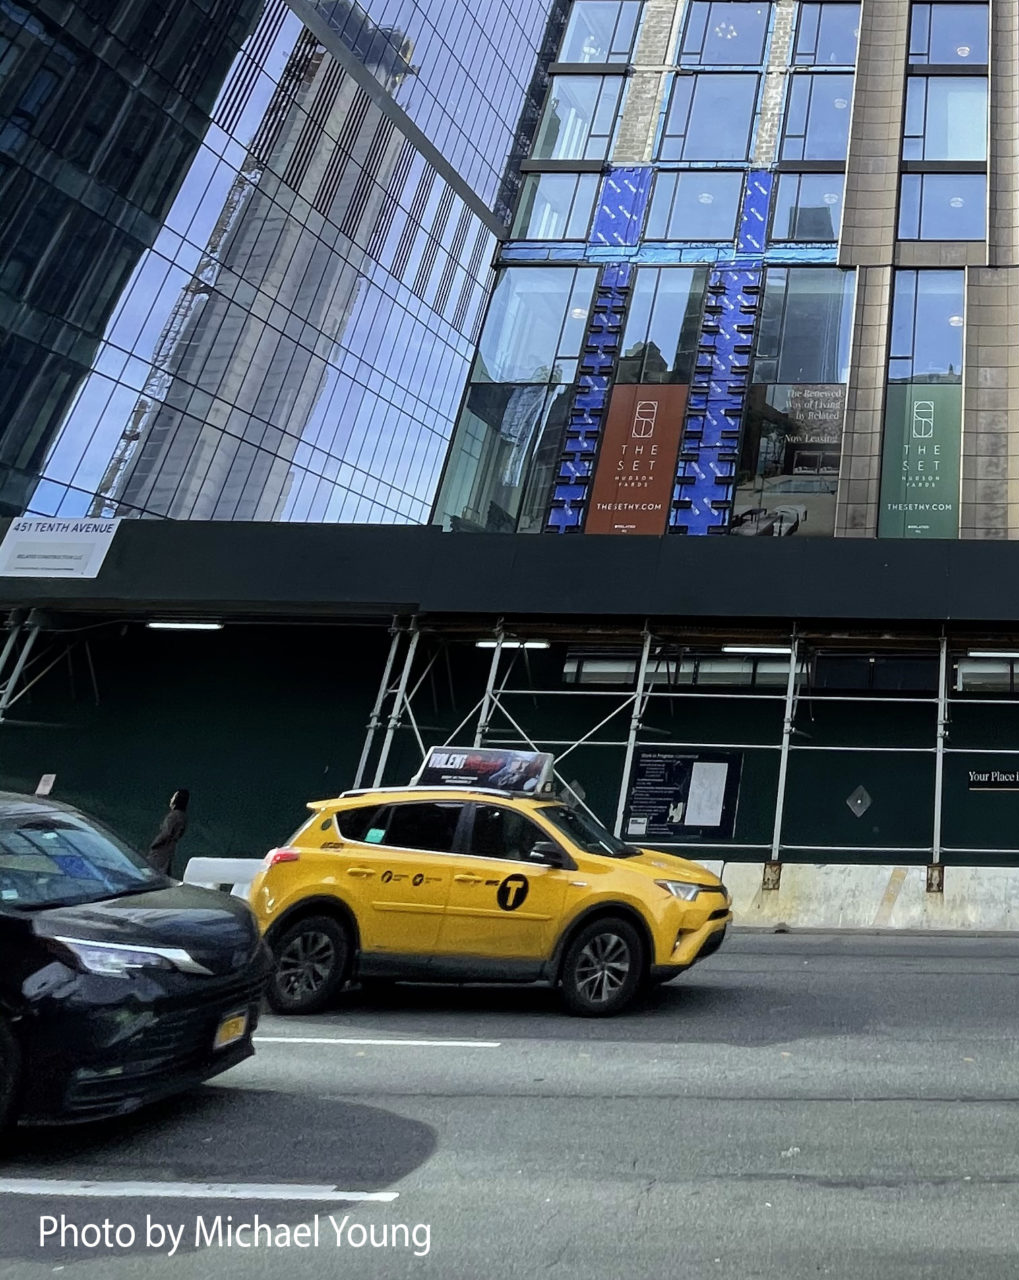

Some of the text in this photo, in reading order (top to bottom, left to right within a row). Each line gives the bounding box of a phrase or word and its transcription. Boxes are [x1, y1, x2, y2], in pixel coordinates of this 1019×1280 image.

[621, 445, 658, 455] THE
[904, 445, 940, 455] THE
[617, 461, 656, 471] SET
[902, 461, 940, 471] SET
[13, 522, 115, 534] 451 TENTH AVENUE
[969, 771, 989, 782] Your
[991, 771, 1015, 782] Place
[506, 880, 525, 907] T
